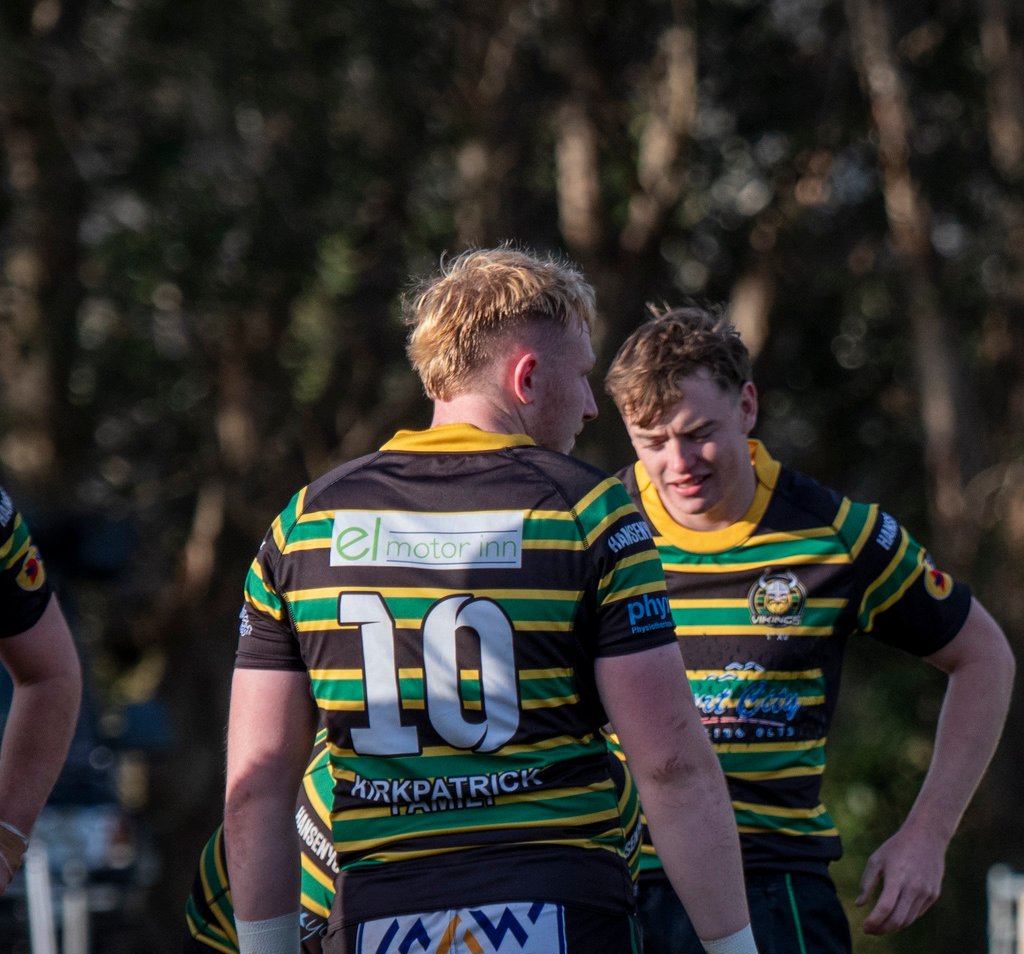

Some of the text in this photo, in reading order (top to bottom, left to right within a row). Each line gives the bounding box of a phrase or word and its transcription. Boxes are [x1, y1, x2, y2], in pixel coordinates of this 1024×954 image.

[336, 517, 517, 561] el motor inn
[751, 615, 801, 626] VIKINGS
[338, 592, 520, 757] 10
[351, 768, 544, 802] KIRKPATRICK
